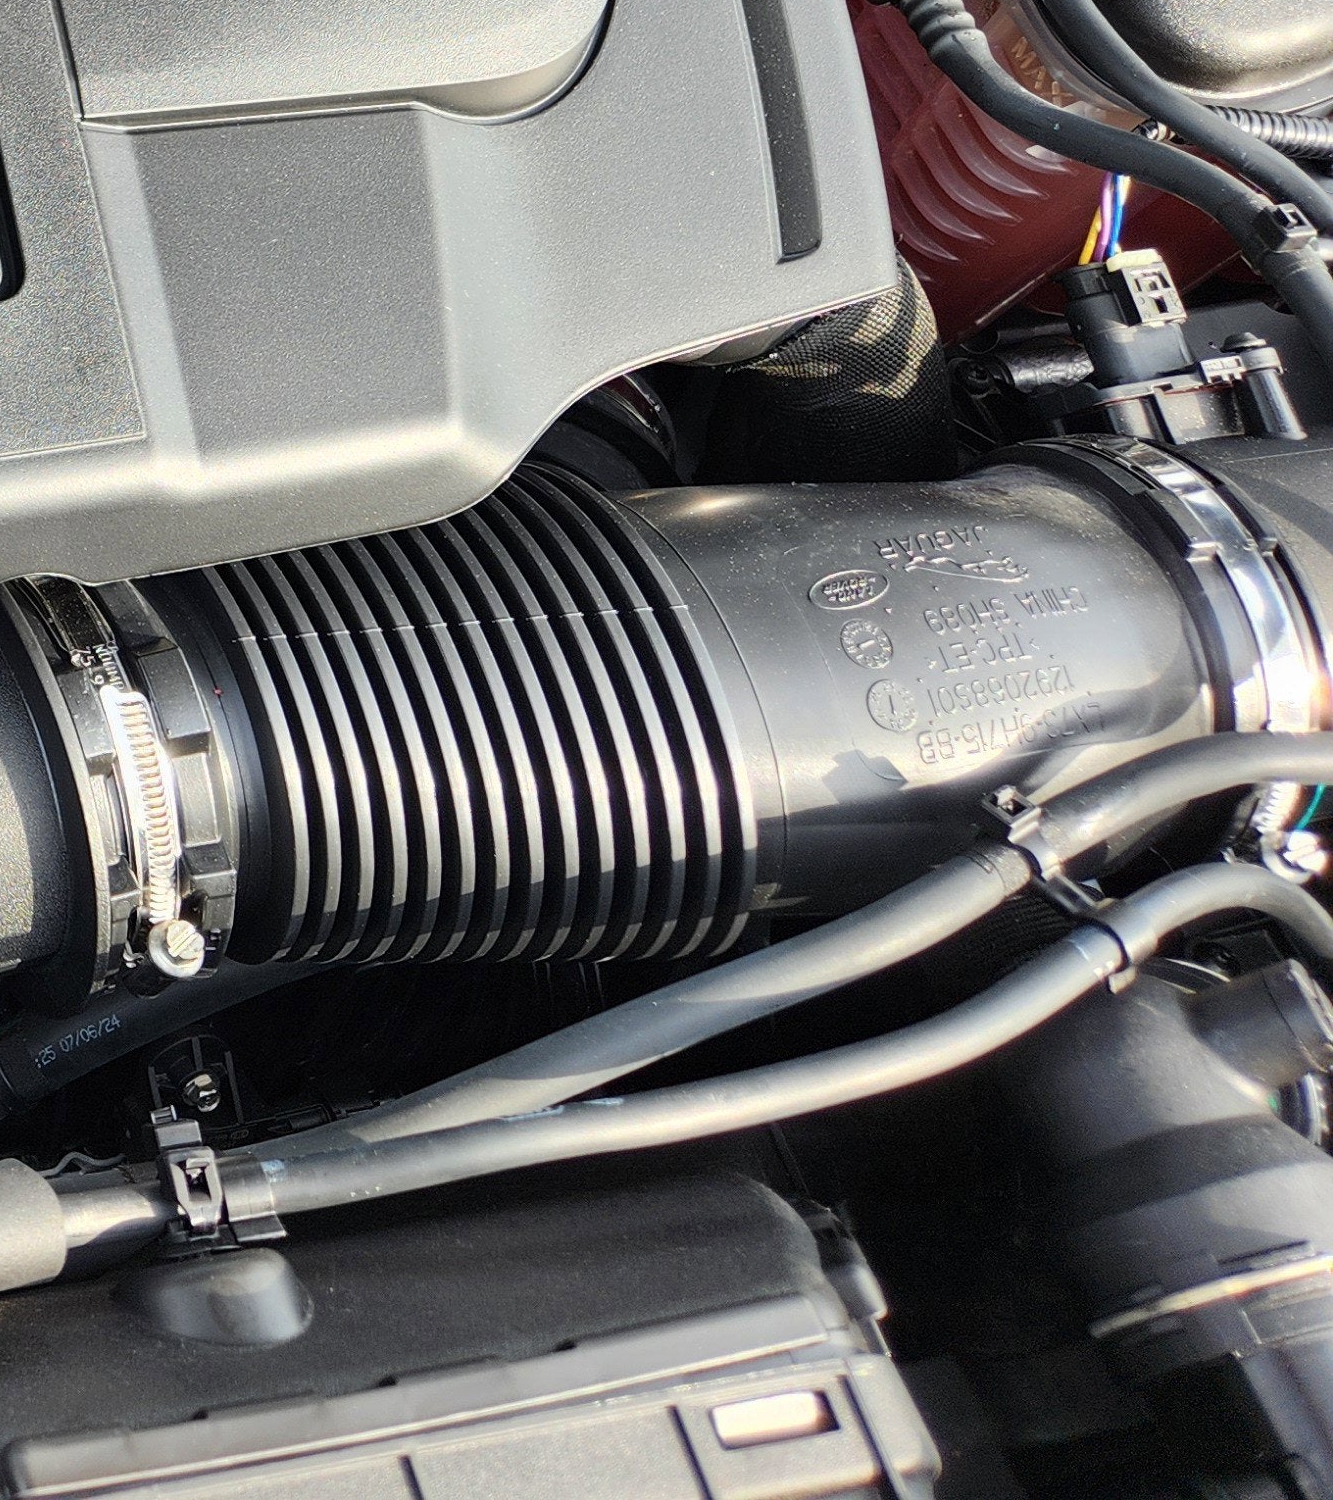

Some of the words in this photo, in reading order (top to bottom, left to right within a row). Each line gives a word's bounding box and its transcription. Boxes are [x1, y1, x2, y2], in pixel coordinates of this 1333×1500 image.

[1011, 34, 1073, 105] MAX
[872, 525, 987, 560] JAGUAR
[1013, 585, 1089, 619] CHINA
[59, 1012, 121, 1053] 07/06/24
